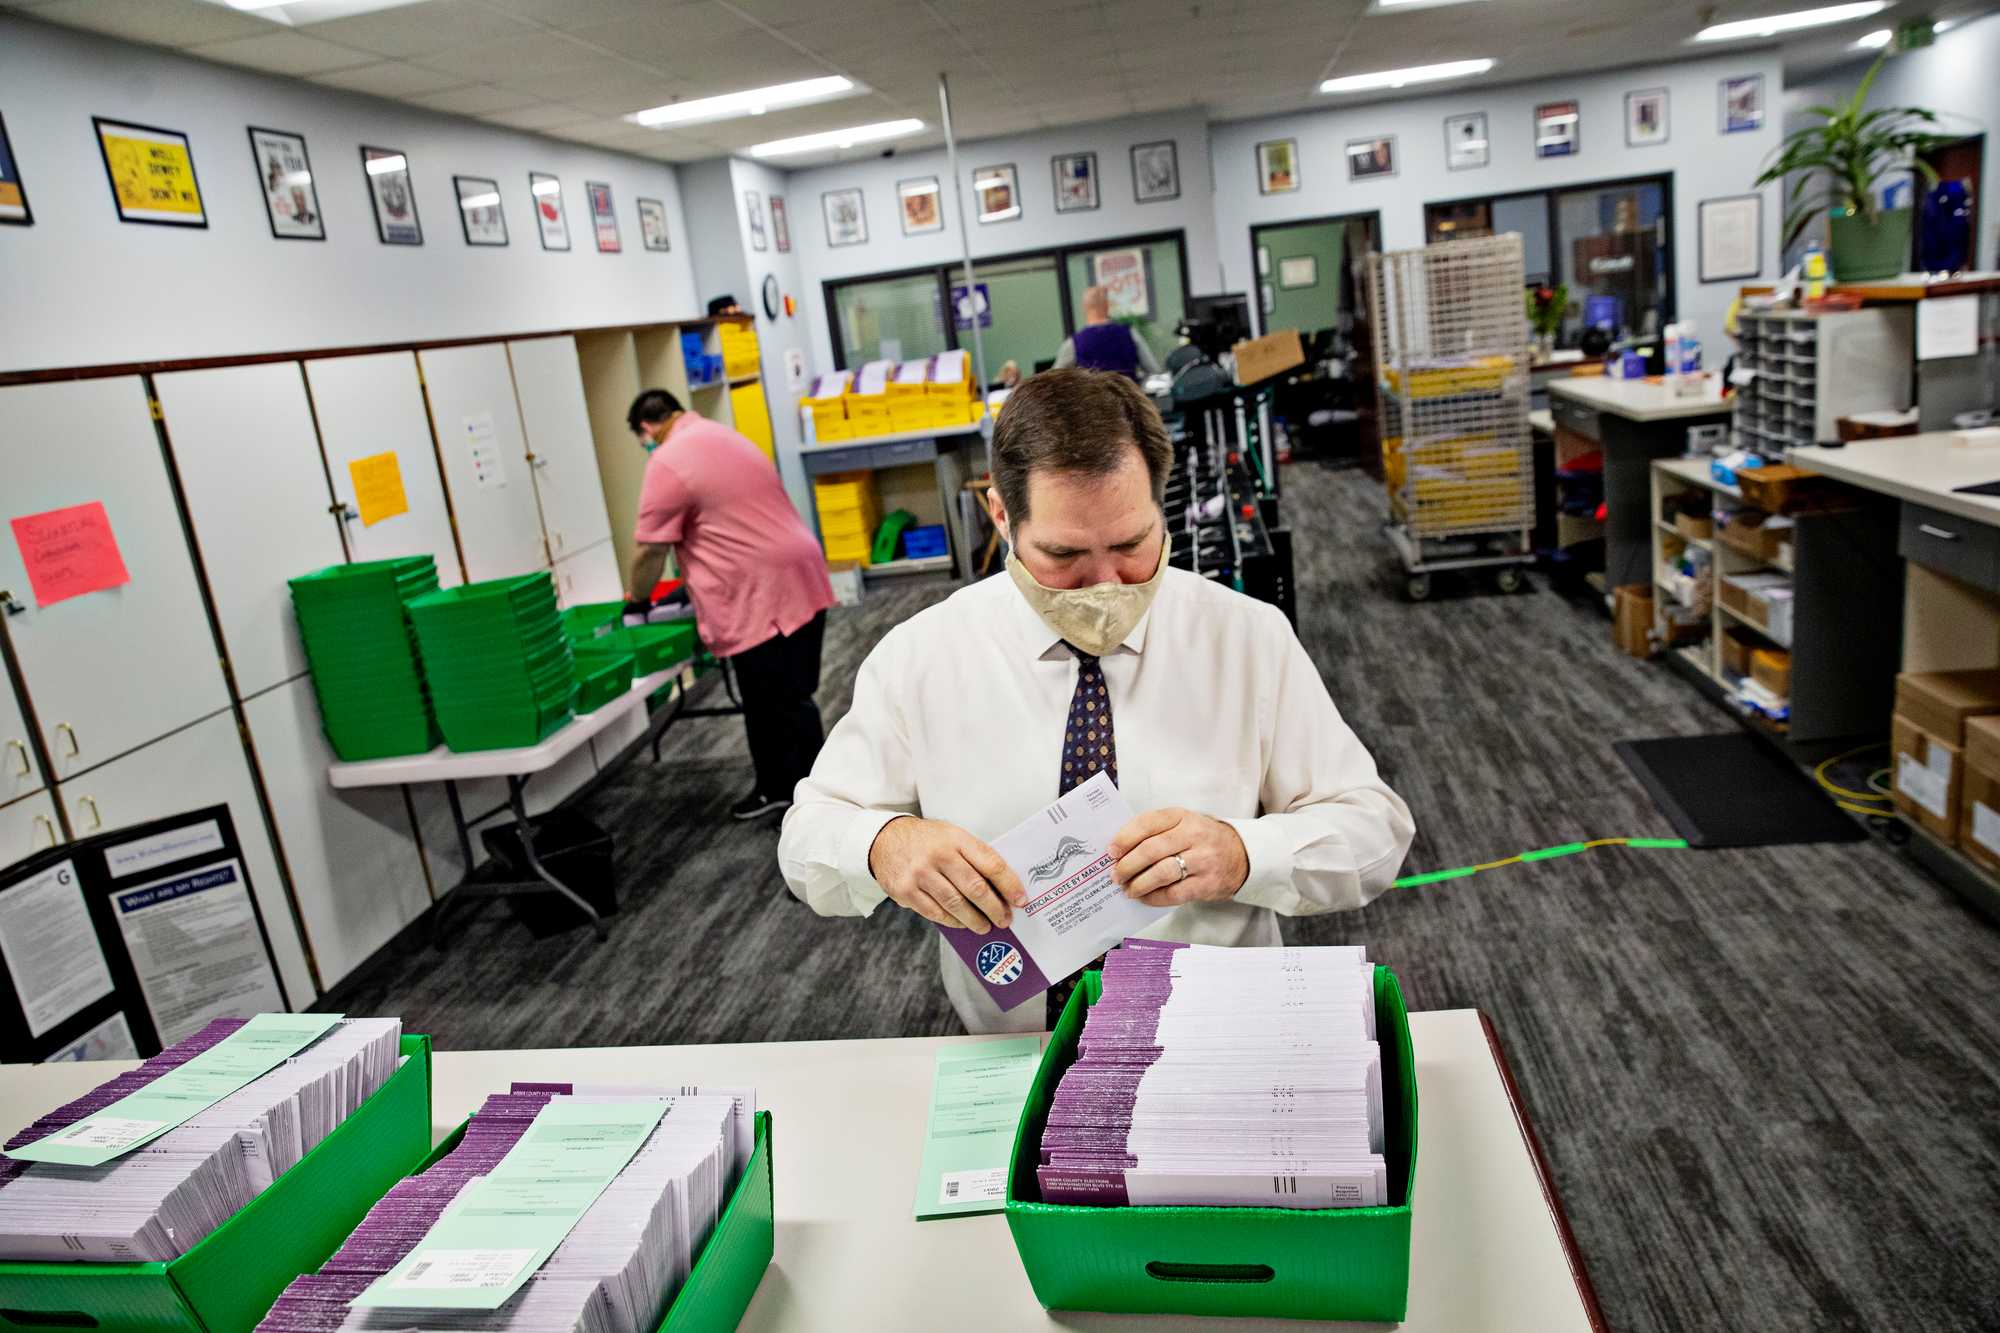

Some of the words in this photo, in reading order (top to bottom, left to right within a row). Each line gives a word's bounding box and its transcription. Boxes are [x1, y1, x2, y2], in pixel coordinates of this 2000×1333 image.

[57, 869, 71, 885] G
[1025, 894, 1054, 914] OFFICIAL
[1053, 883, 1071, 896] VOTE
[1072, 876, 1081, 885] BY
[1081, 865, 1100, 878] MAIL
[1099, 856, 1113, 867] BAL
[1048, 910, 1064, 923] WEBER
[1064, 898, 1084, 912] COUNTY
[1085, 880, 1113, 900] CLERK/AUD
[1051, 917, 1065, 927] RICKY
[1065, 907, 1082, 918] HATCH
